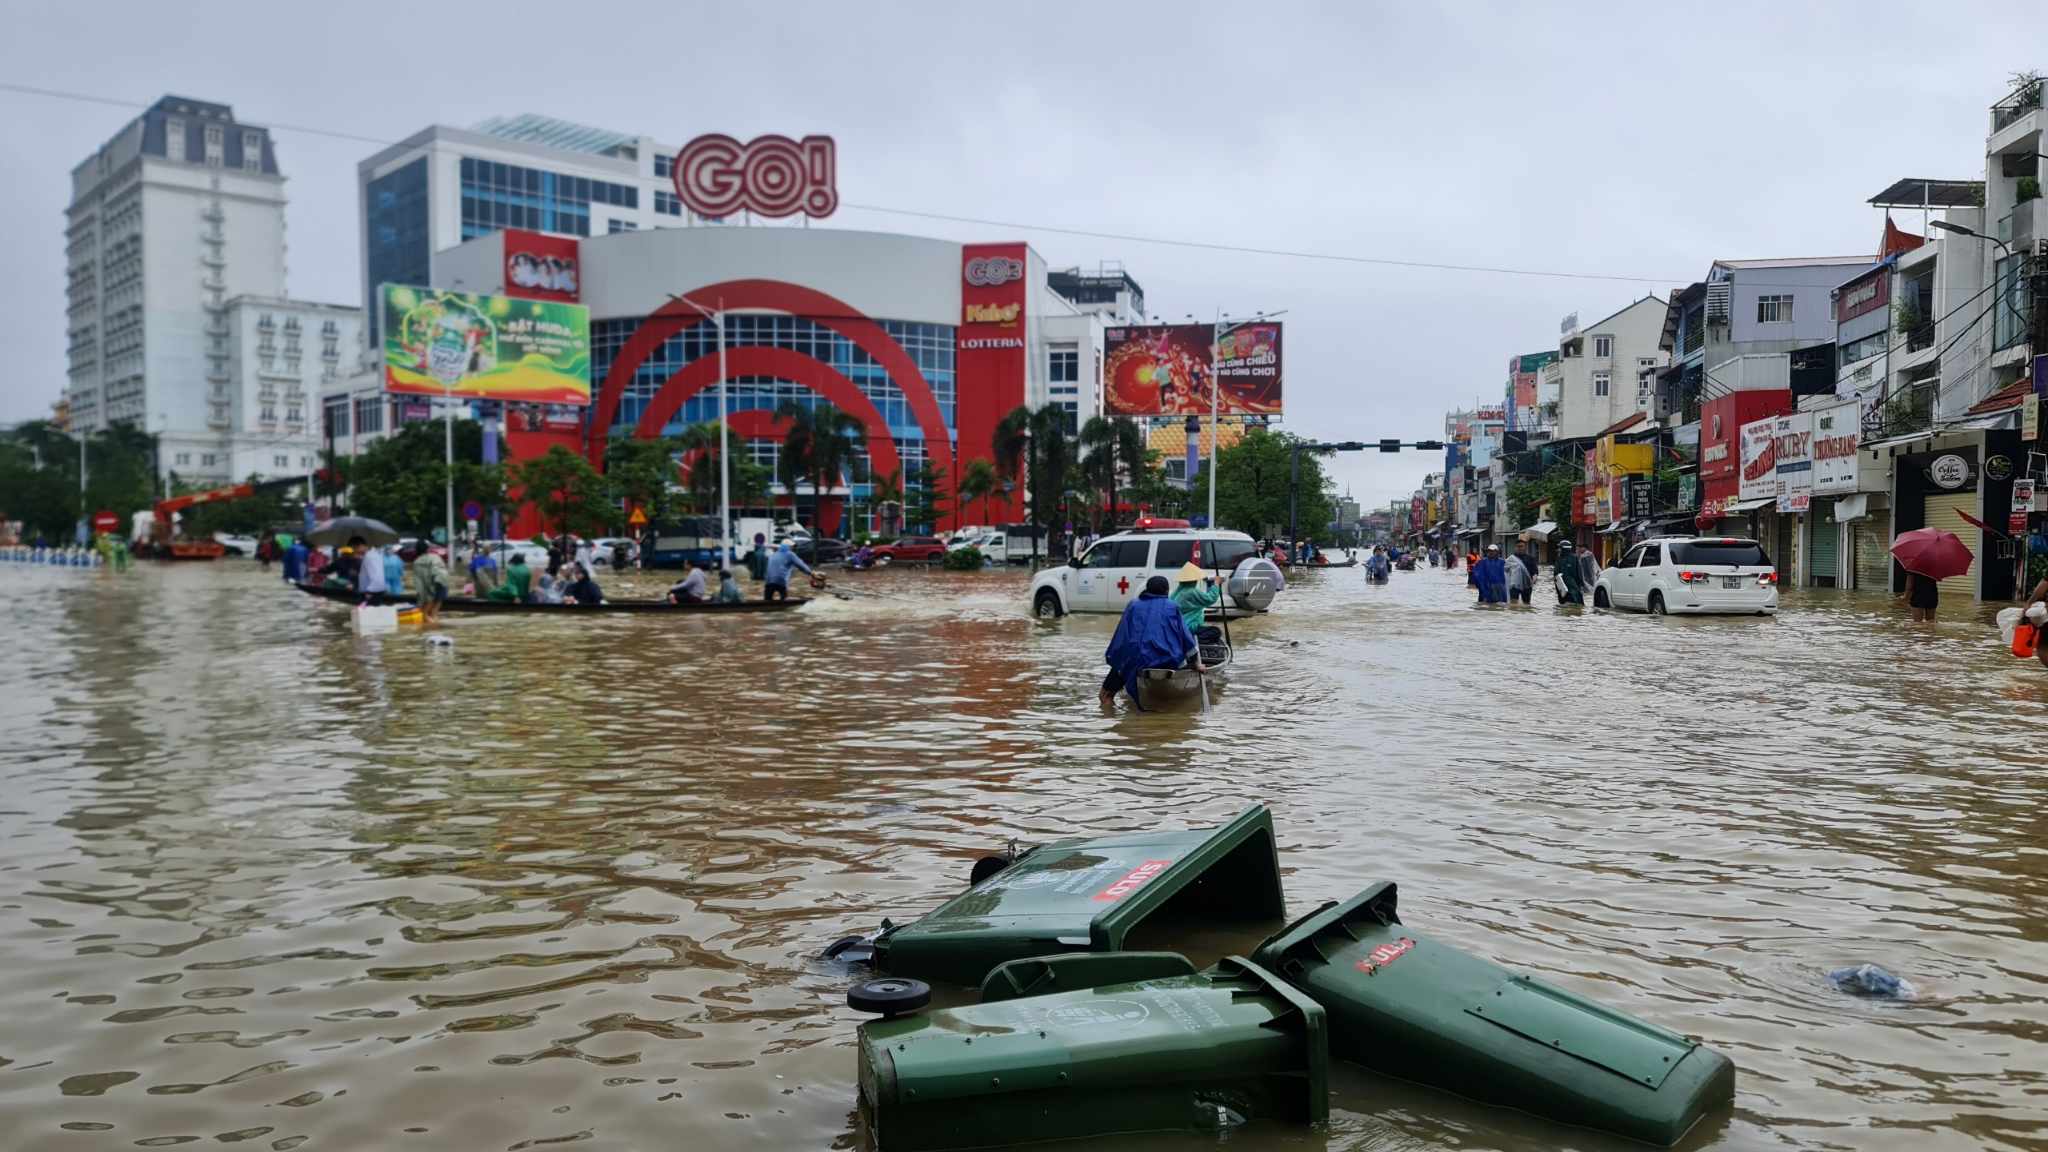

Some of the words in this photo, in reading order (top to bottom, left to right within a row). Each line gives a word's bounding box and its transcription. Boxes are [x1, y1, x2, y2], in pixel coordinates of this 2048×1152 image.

[673, 134, 838, 219] GO!
[961, 338, 1024, 349] LOTTERIA
[1776, 431, 1811, 460] RUBY
[1106, 862, 1162, 896] SULO
